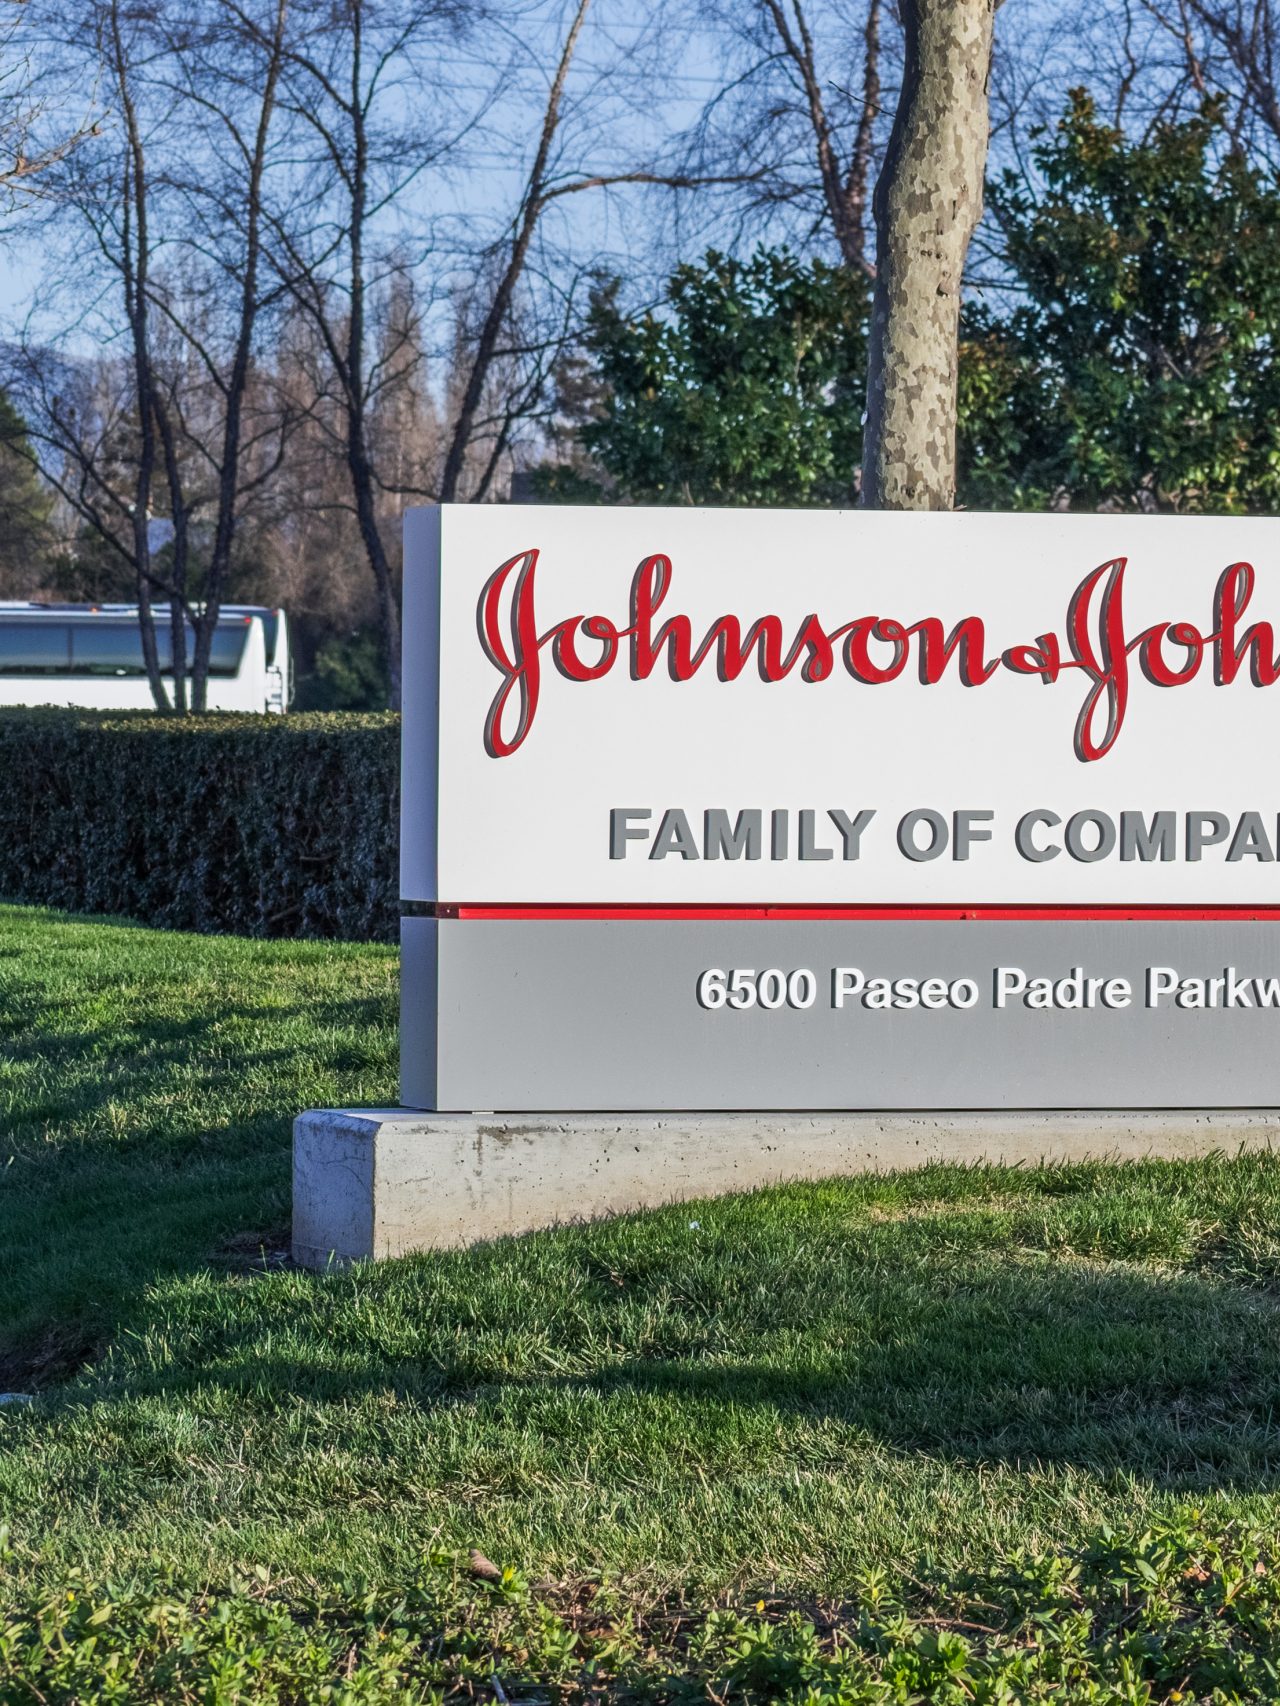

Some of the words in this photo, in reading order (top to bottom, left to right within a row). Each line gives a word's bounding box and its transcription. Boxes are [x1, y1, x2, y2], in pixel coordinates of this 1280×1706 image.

[476, 548, 1001, 759] Johnson
[608, 808, 877, 861] FAMILY
[896, 808, 995, 862] OF
[697, 968, 817, 1010] 6500
[832, 967, 980, 1010] Paseo
[994, 967, 1132, 1009] Padre
